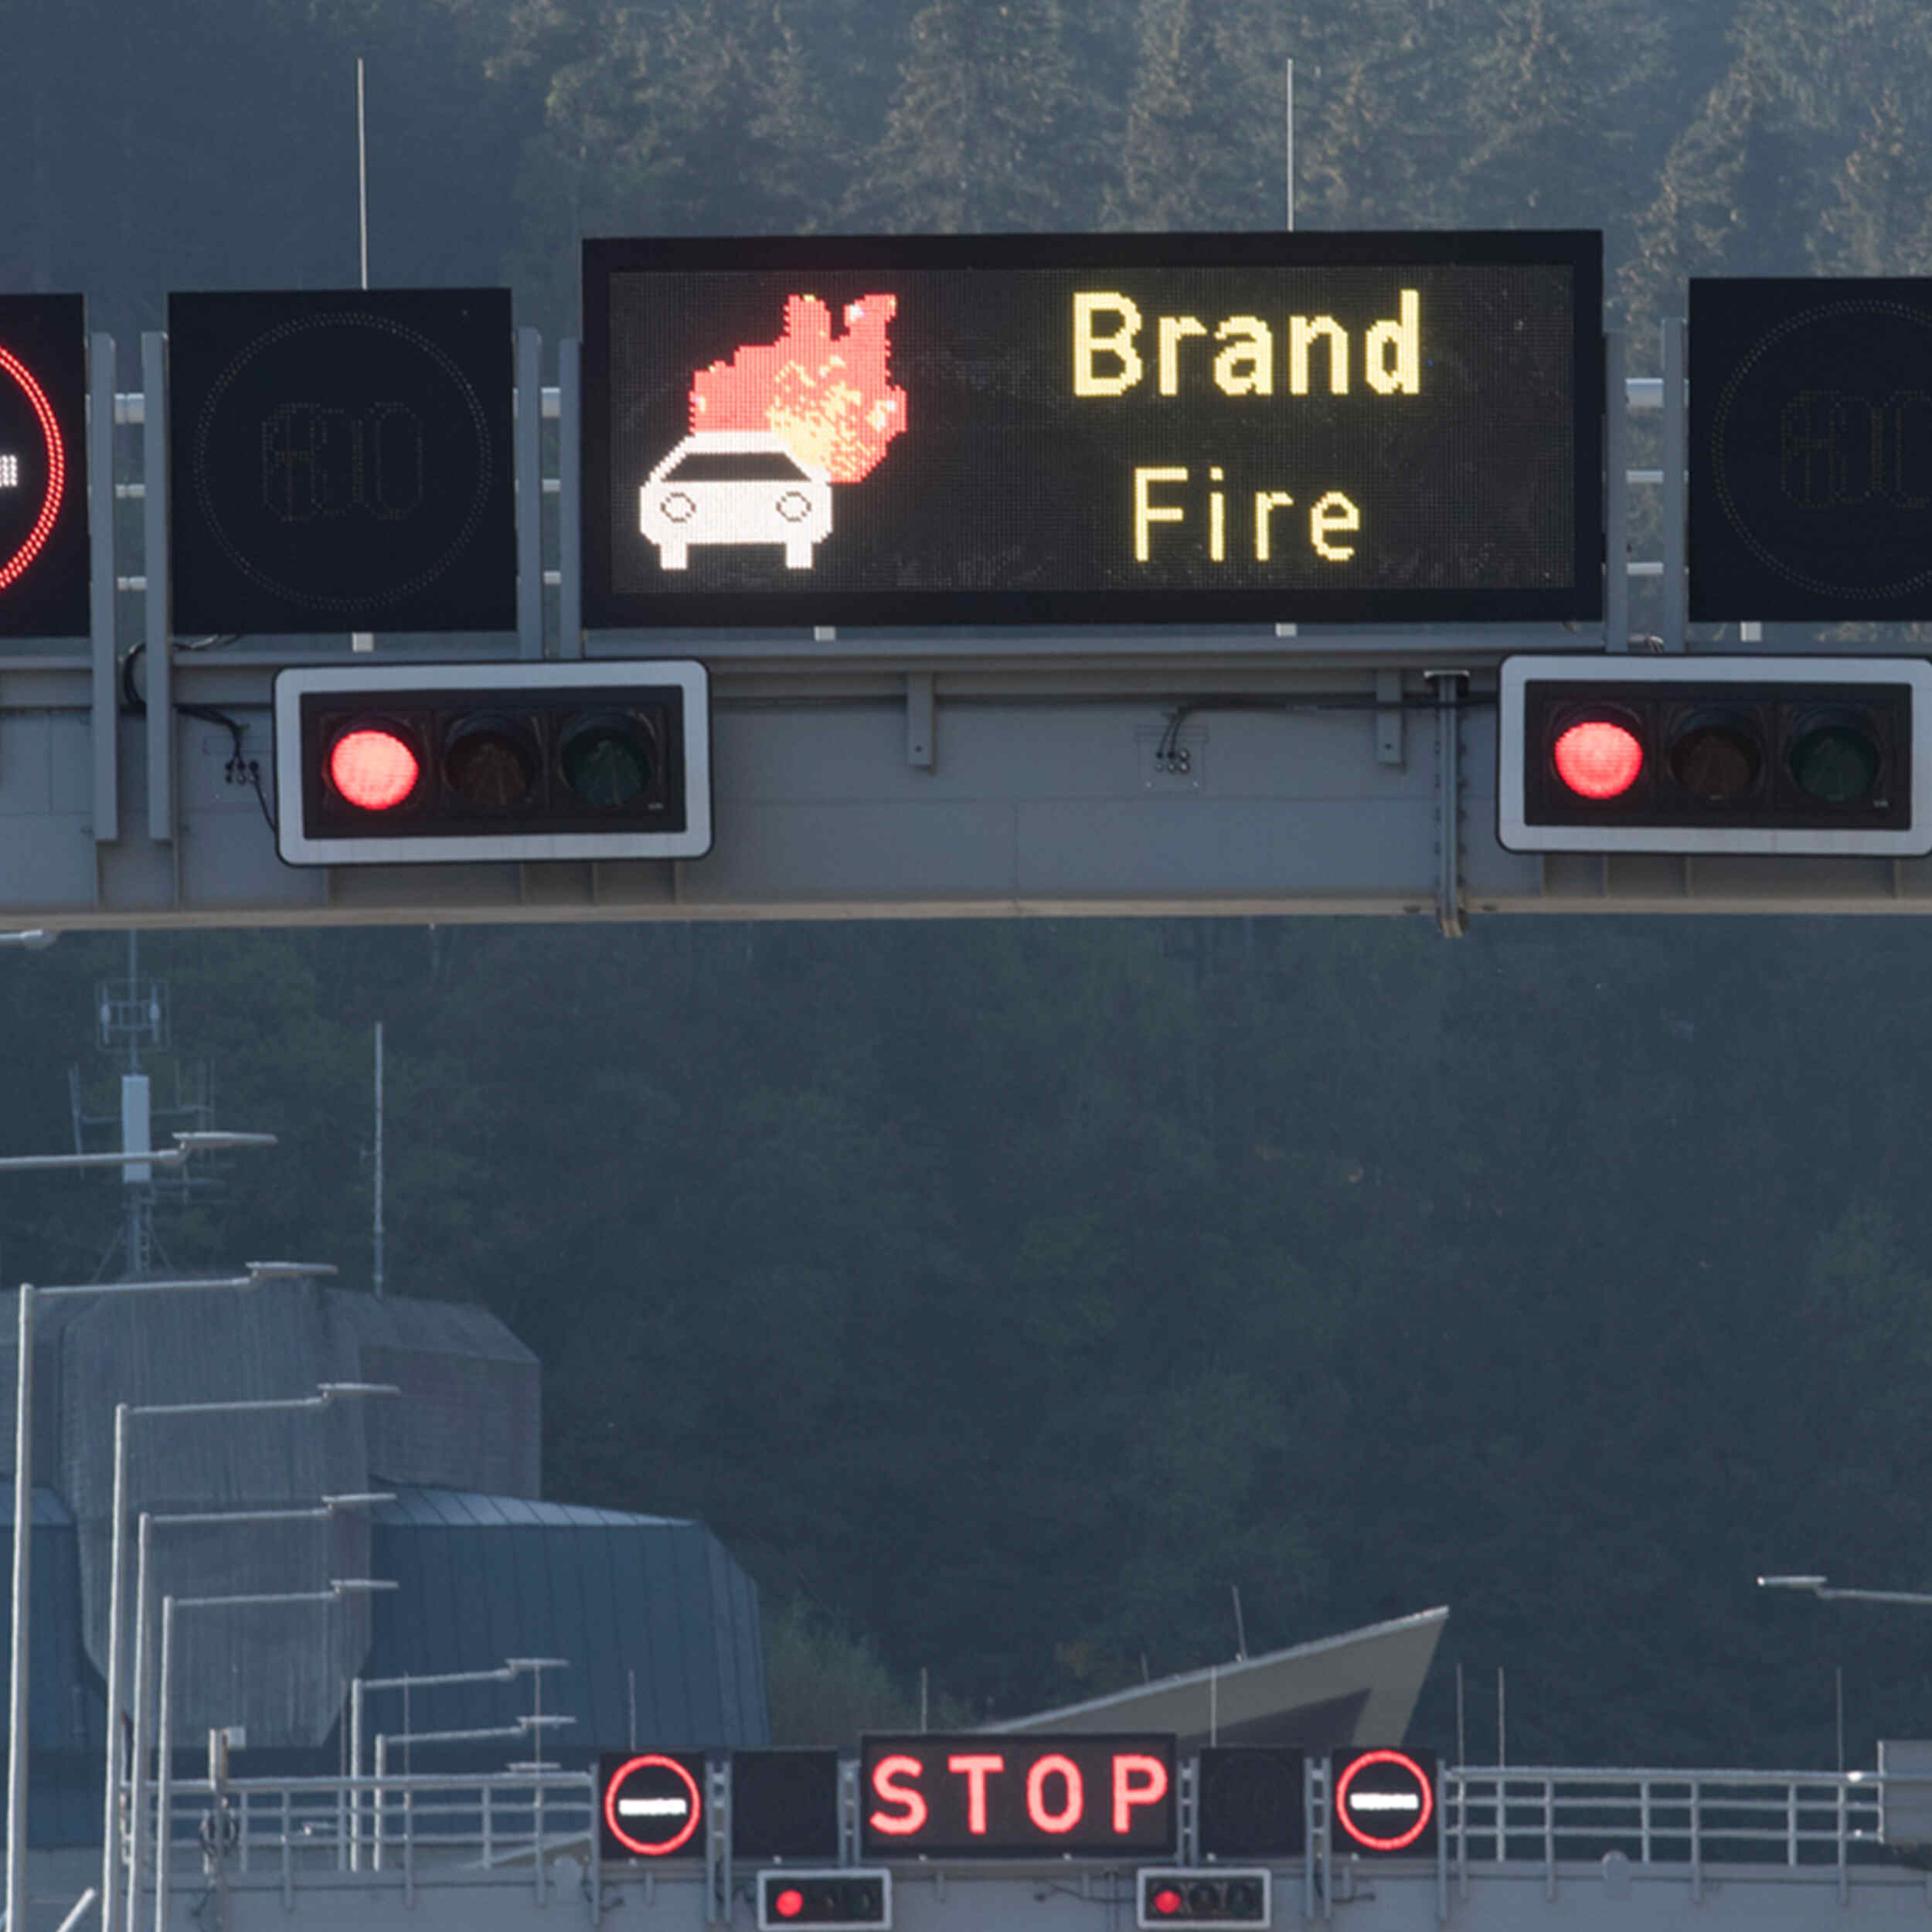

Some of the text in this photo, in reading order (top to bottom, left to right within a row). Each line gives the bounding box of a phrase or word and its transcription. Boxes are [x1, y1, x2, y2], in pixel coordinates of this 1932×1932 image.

[1073, 289, 1420, 396] Brand
[1134, 467, 1360, 562] Fire
[869, 1753, 1168, 1835] STOP
